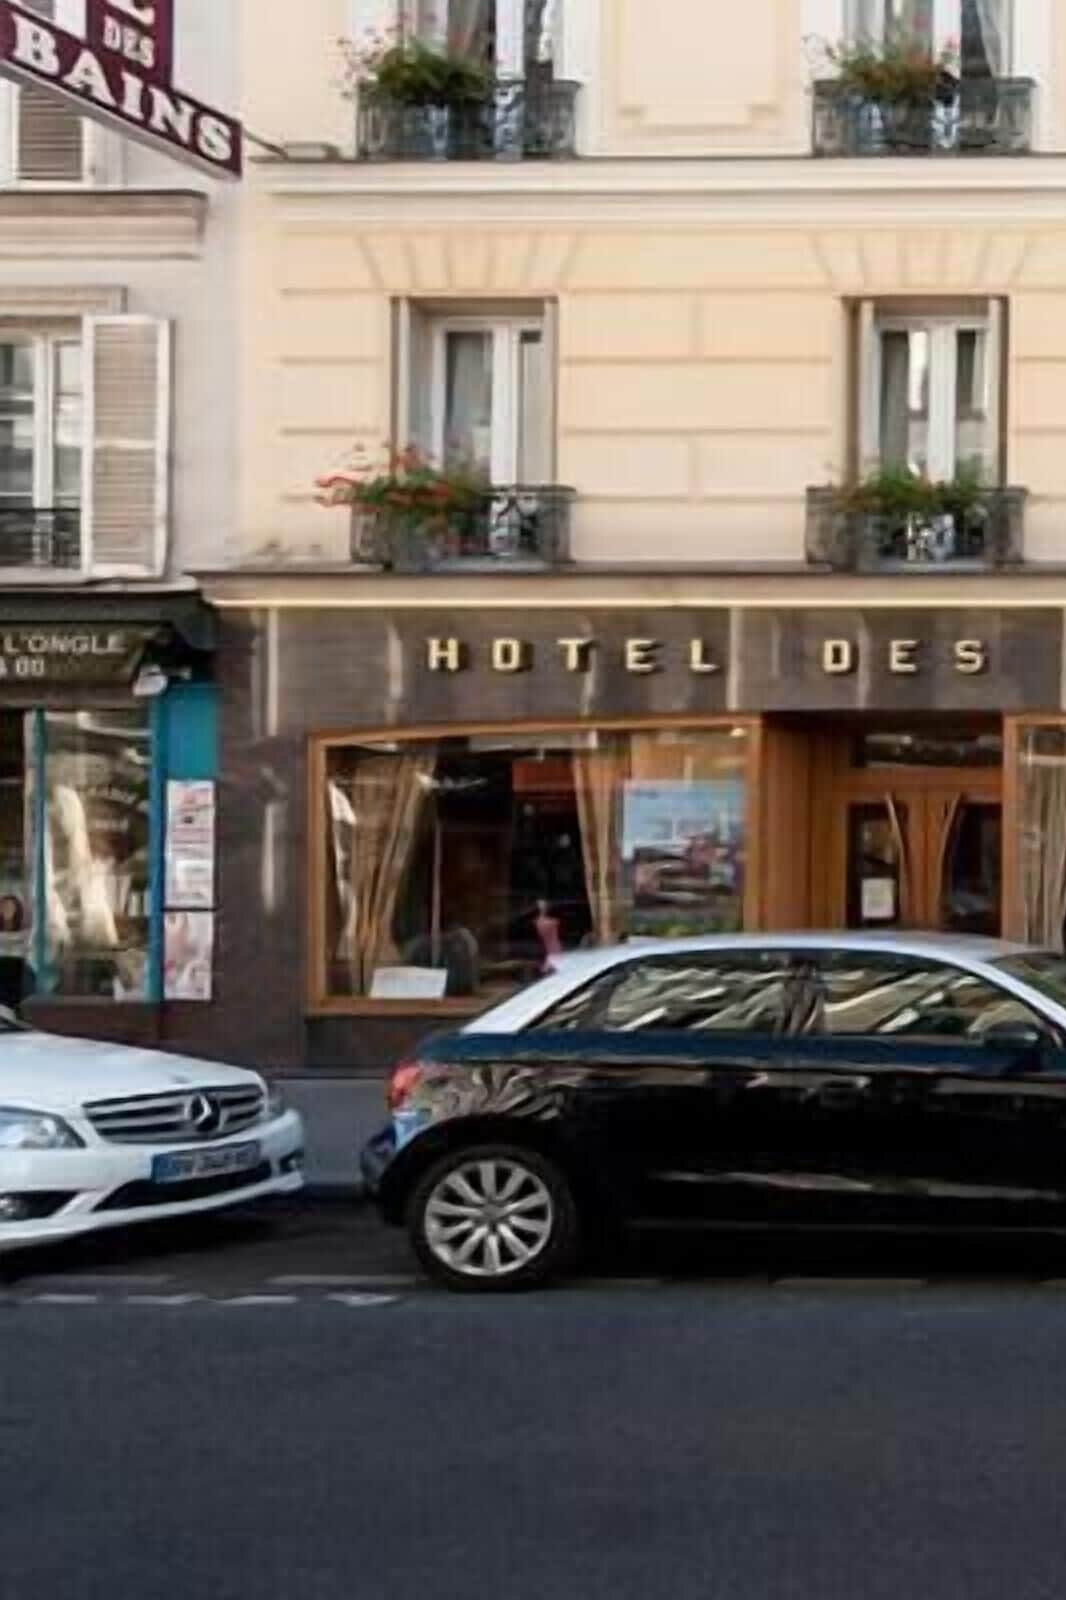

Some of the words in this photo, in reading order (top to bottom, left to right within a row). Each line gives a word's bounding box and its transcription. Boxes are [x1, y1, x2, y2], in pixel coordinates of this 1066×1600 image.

[103, 14, 155, 69] DES
[11, 11, 233, 162] BAINS
[427, 637, 721, 672] HOTEL
[823, 639, 986, 673] DES
